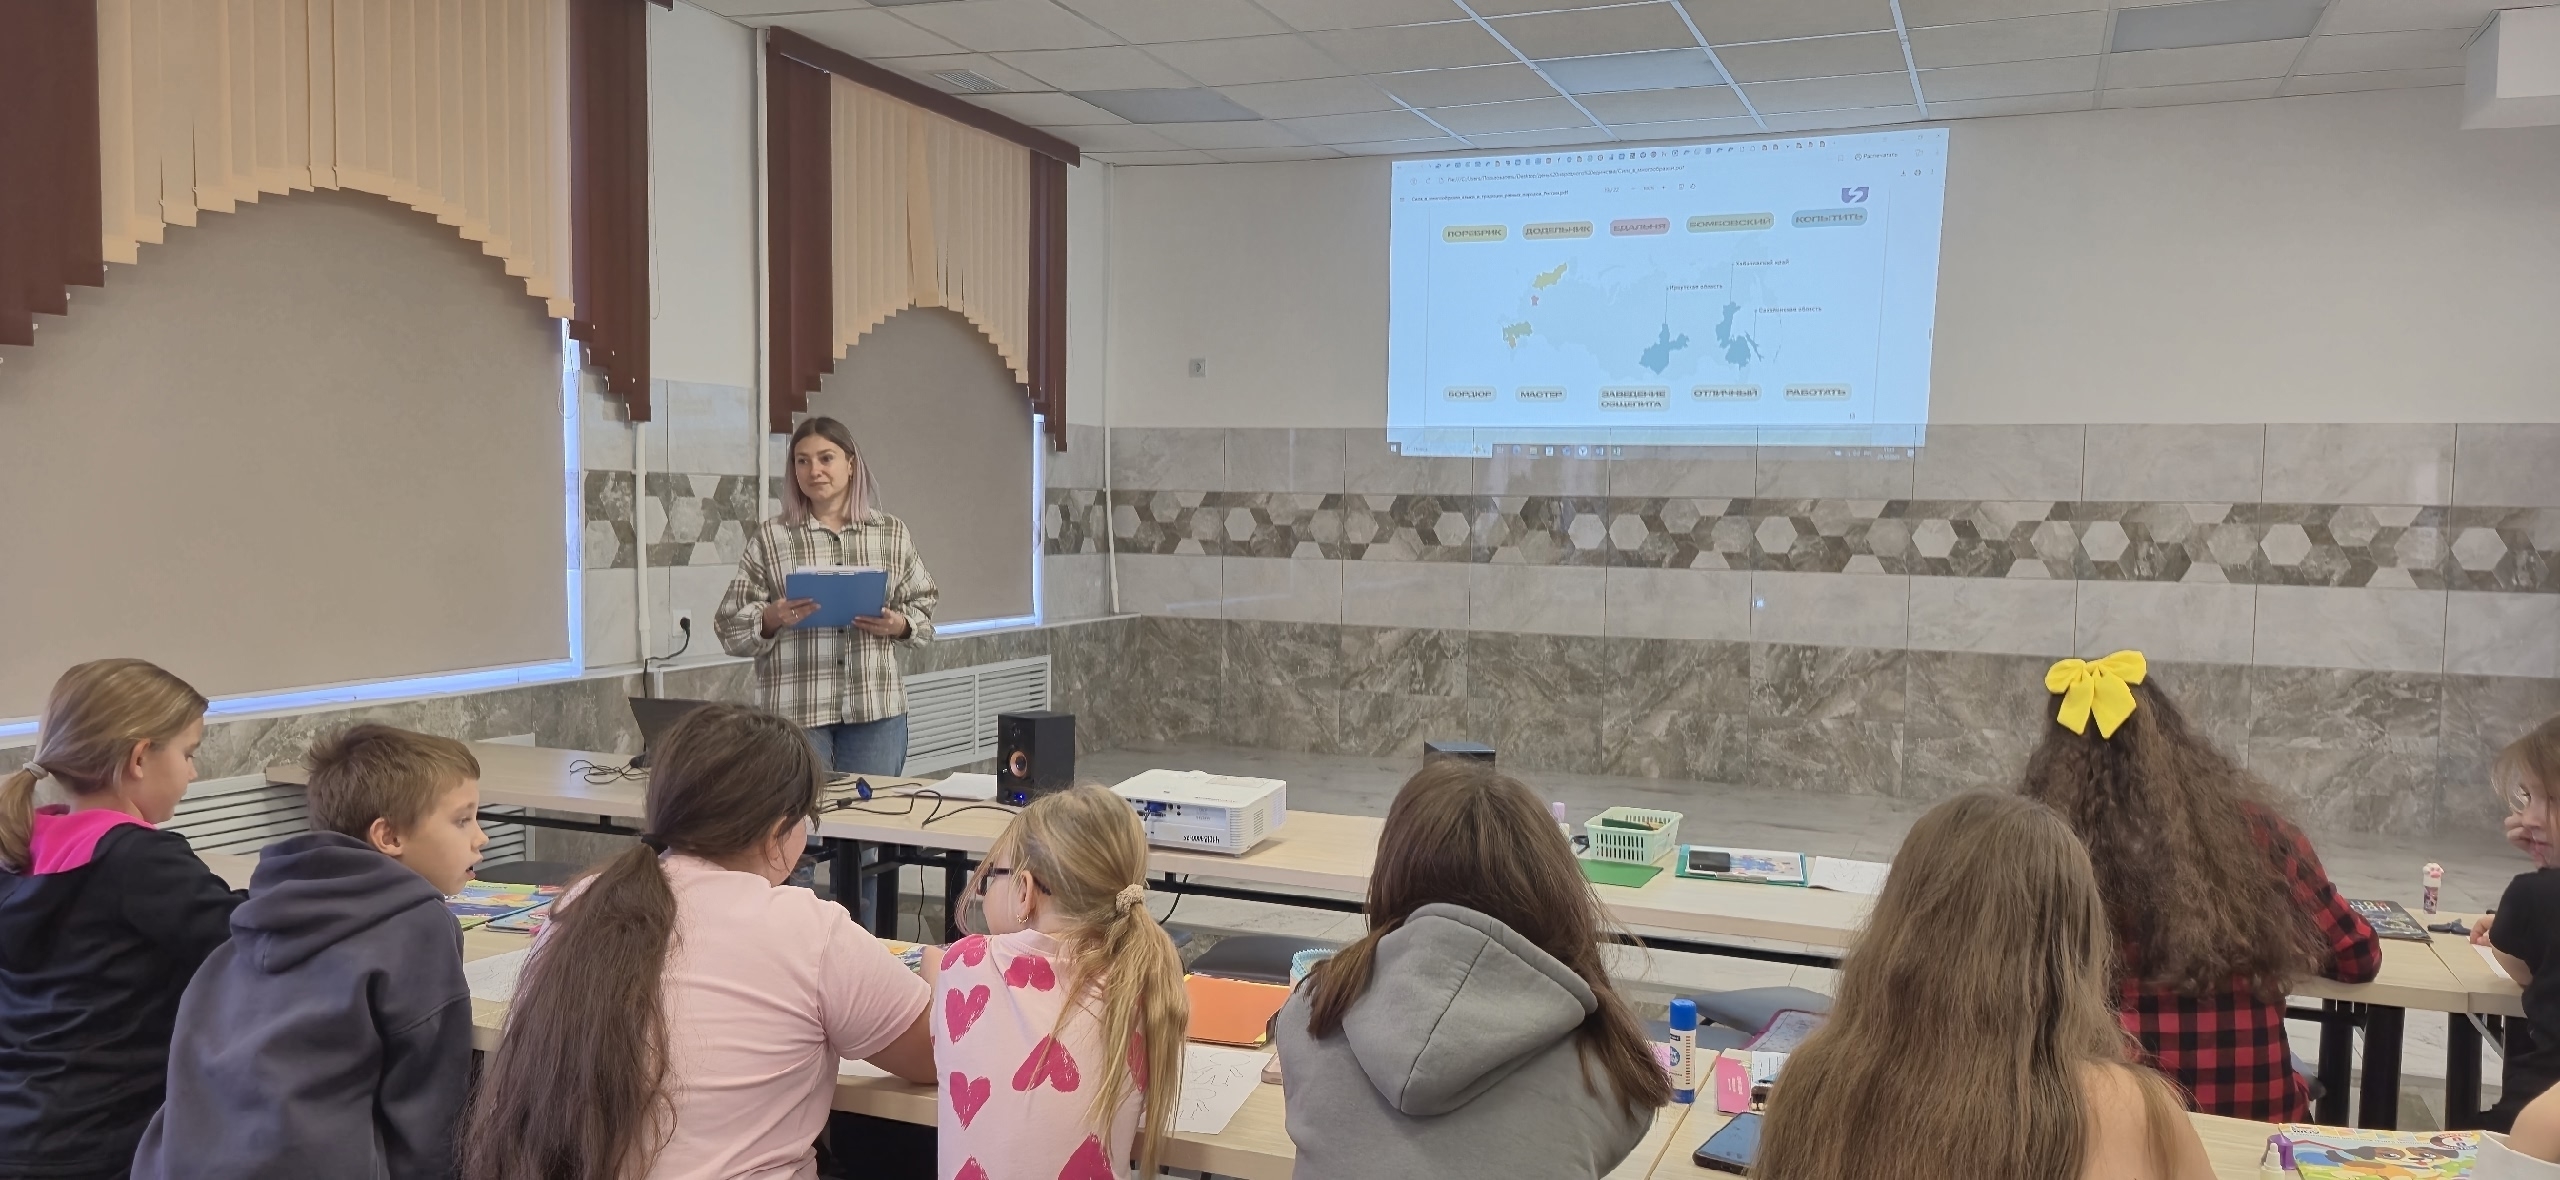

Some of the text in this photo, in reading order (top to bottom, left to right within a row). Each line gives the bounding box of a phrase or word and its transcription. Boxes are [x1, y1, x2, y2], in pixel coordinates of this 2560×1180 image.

[1795, 213, 1863, 223] КОПЫТИТЬ
[1447, 229, 1502, 238] ПОРЕБРИК
[1525, 225, 1591, 236] ДОДЕЛЬНИК
[1601, 390, 1666, 398] ЗАВЕДЕНИЕ
[1694, 387, 1758, 397] ОТЛИЧНЫЙ
[1786, 388, 1846, 396] РАБОТАТЬ
